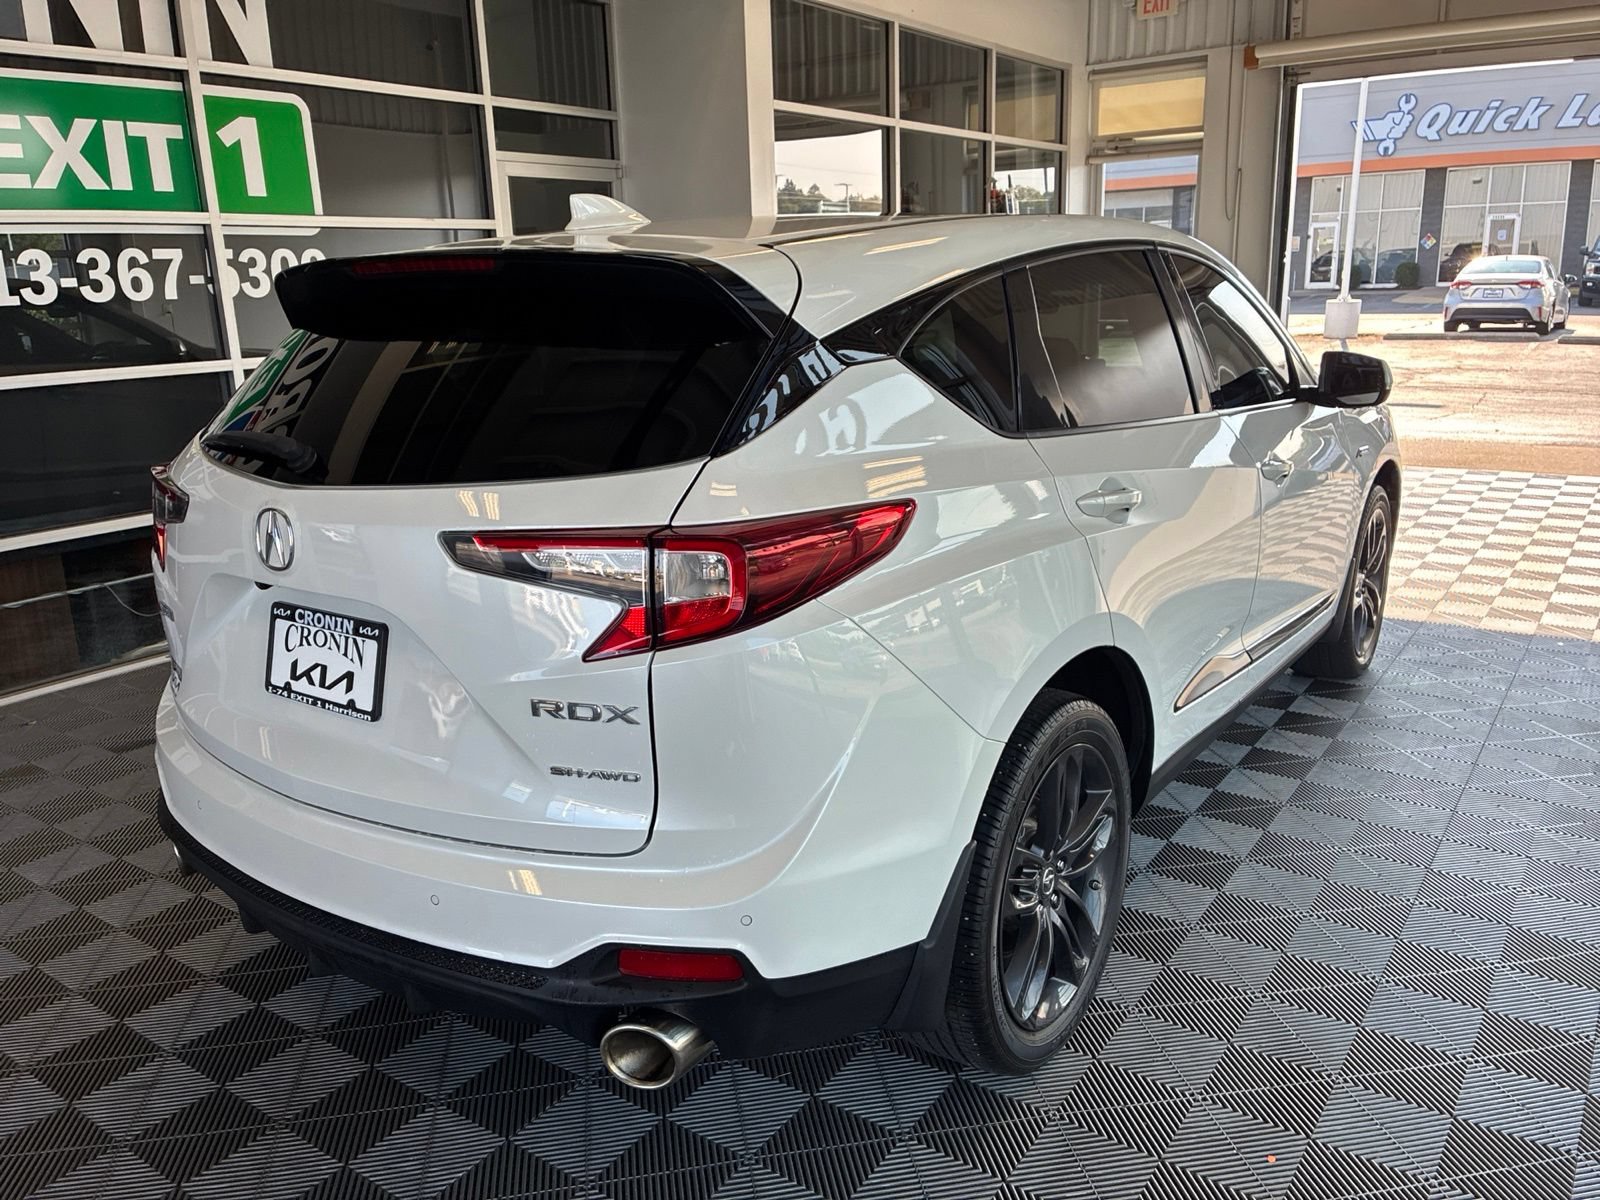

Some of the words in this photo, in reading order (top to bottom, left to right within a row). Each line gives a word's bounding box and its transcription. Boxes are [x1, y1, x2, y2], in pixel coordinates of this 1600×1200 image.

[1416, 96, 1554, 142] Quick
[216, 116, 268, 197] 1
[294, 608, 354, 635] CRONIN
[284, 623, 366, 670] CRONIN
[290, 692, 314, 705] EXIT
[325, 702, 372, 722] Harrison
[530, 698, 641, 725] RDX
